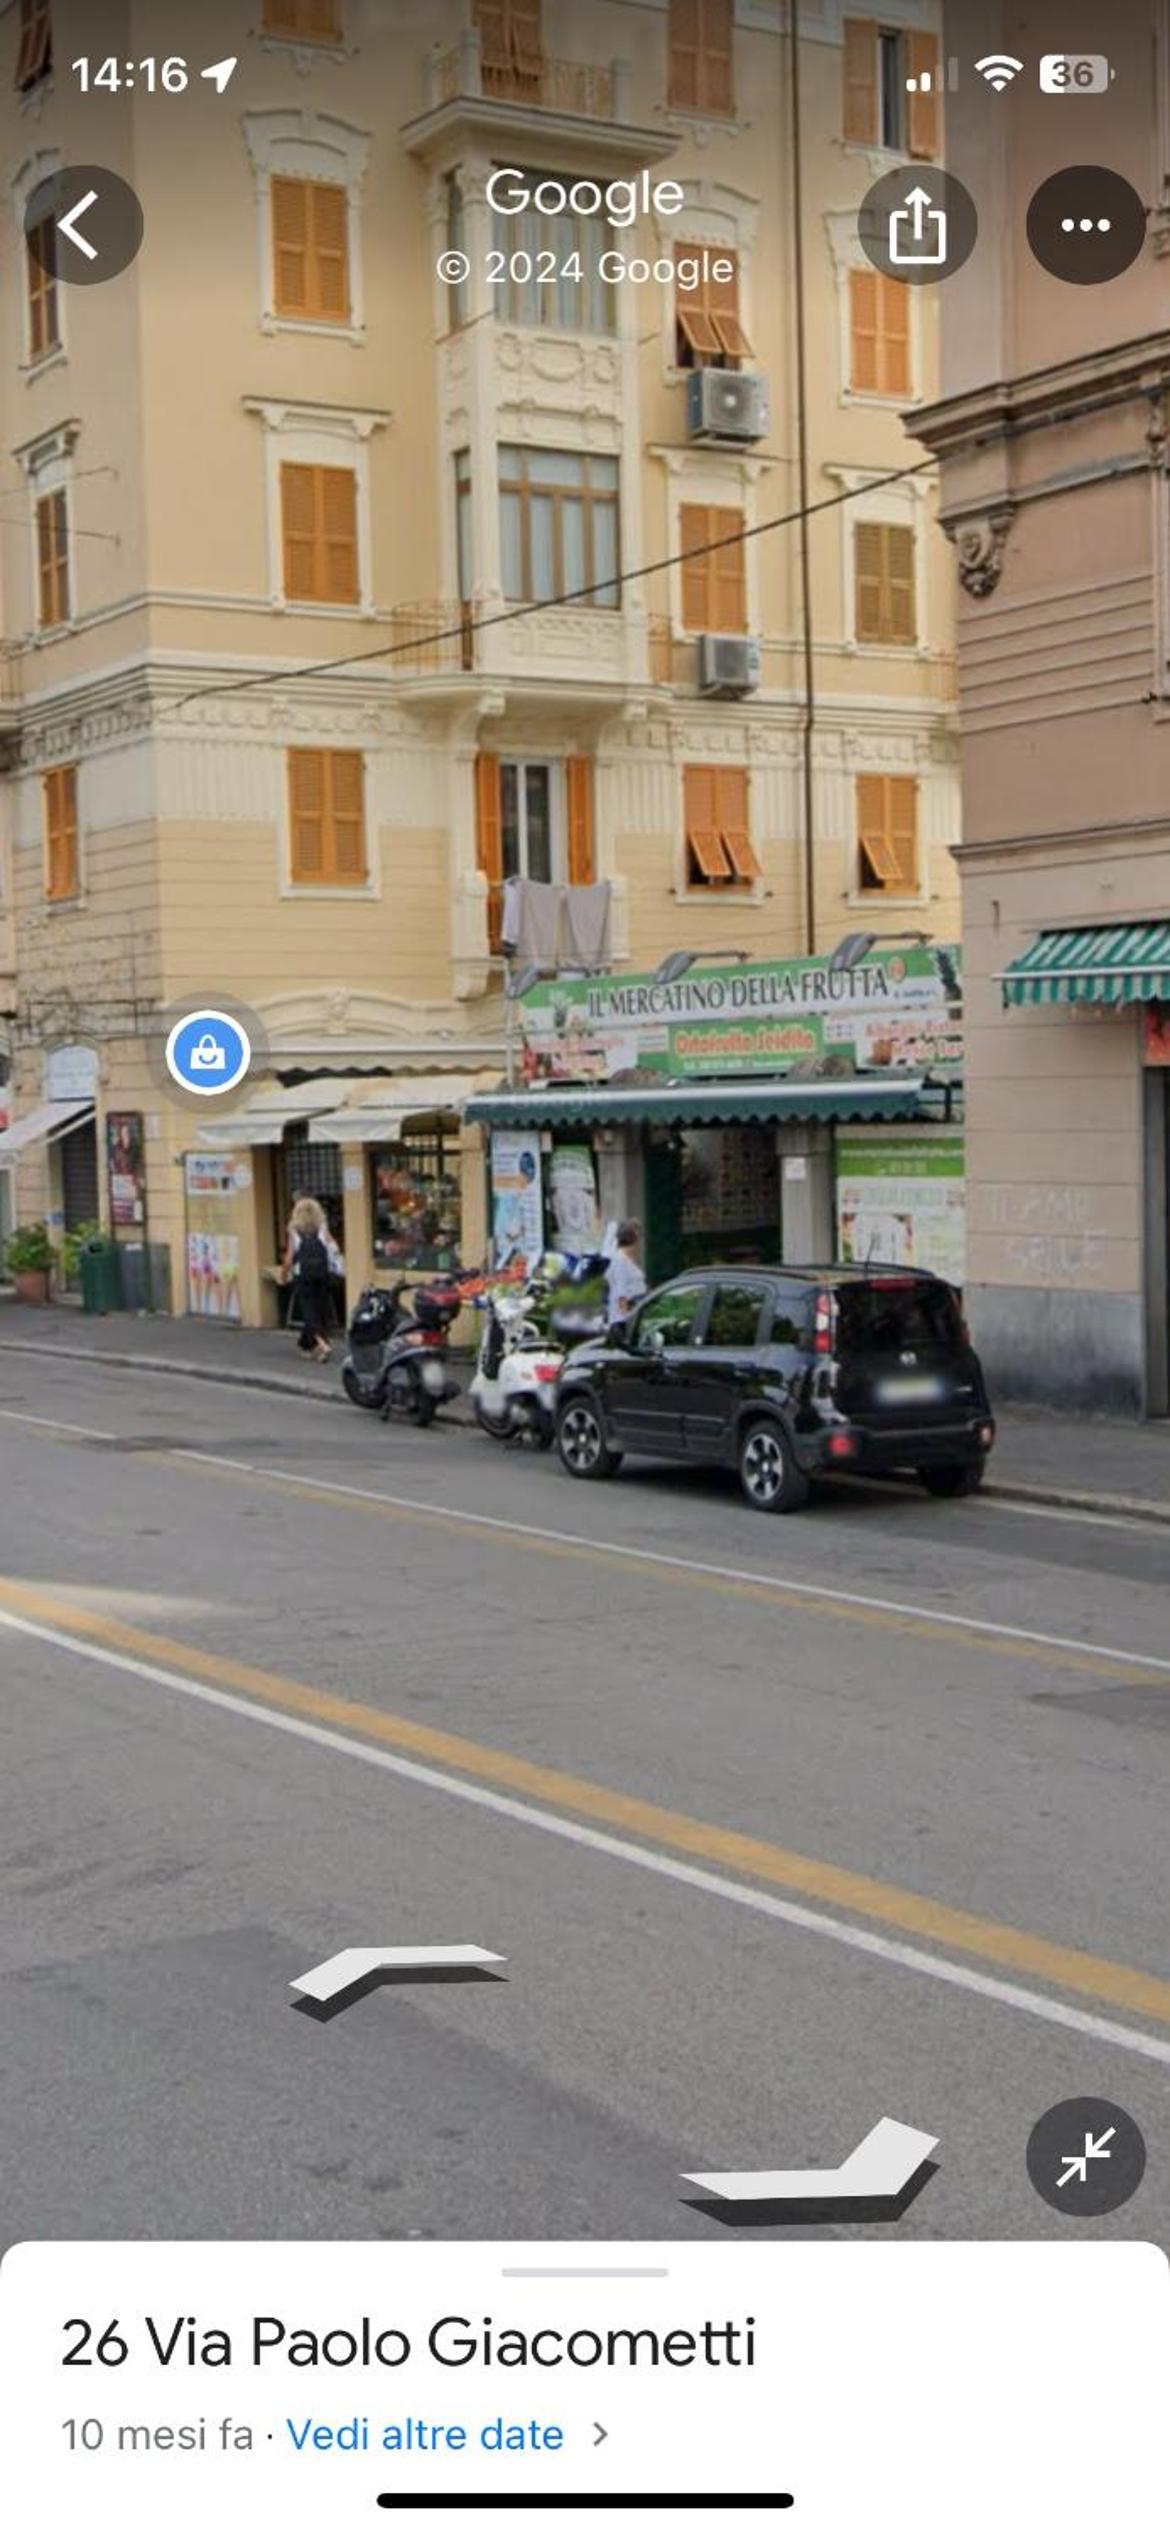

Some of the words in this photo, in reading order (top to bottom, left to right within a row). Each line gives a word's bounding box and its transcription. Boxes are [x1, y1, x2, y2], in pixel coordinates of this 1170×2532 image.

[588, 989, 605, 1018] IL
[609, 981, 726, 1017] MERCATINO
[731, 972, 797, 1008] DELLA
[801, 967, 890, 1002] FRUTTA
